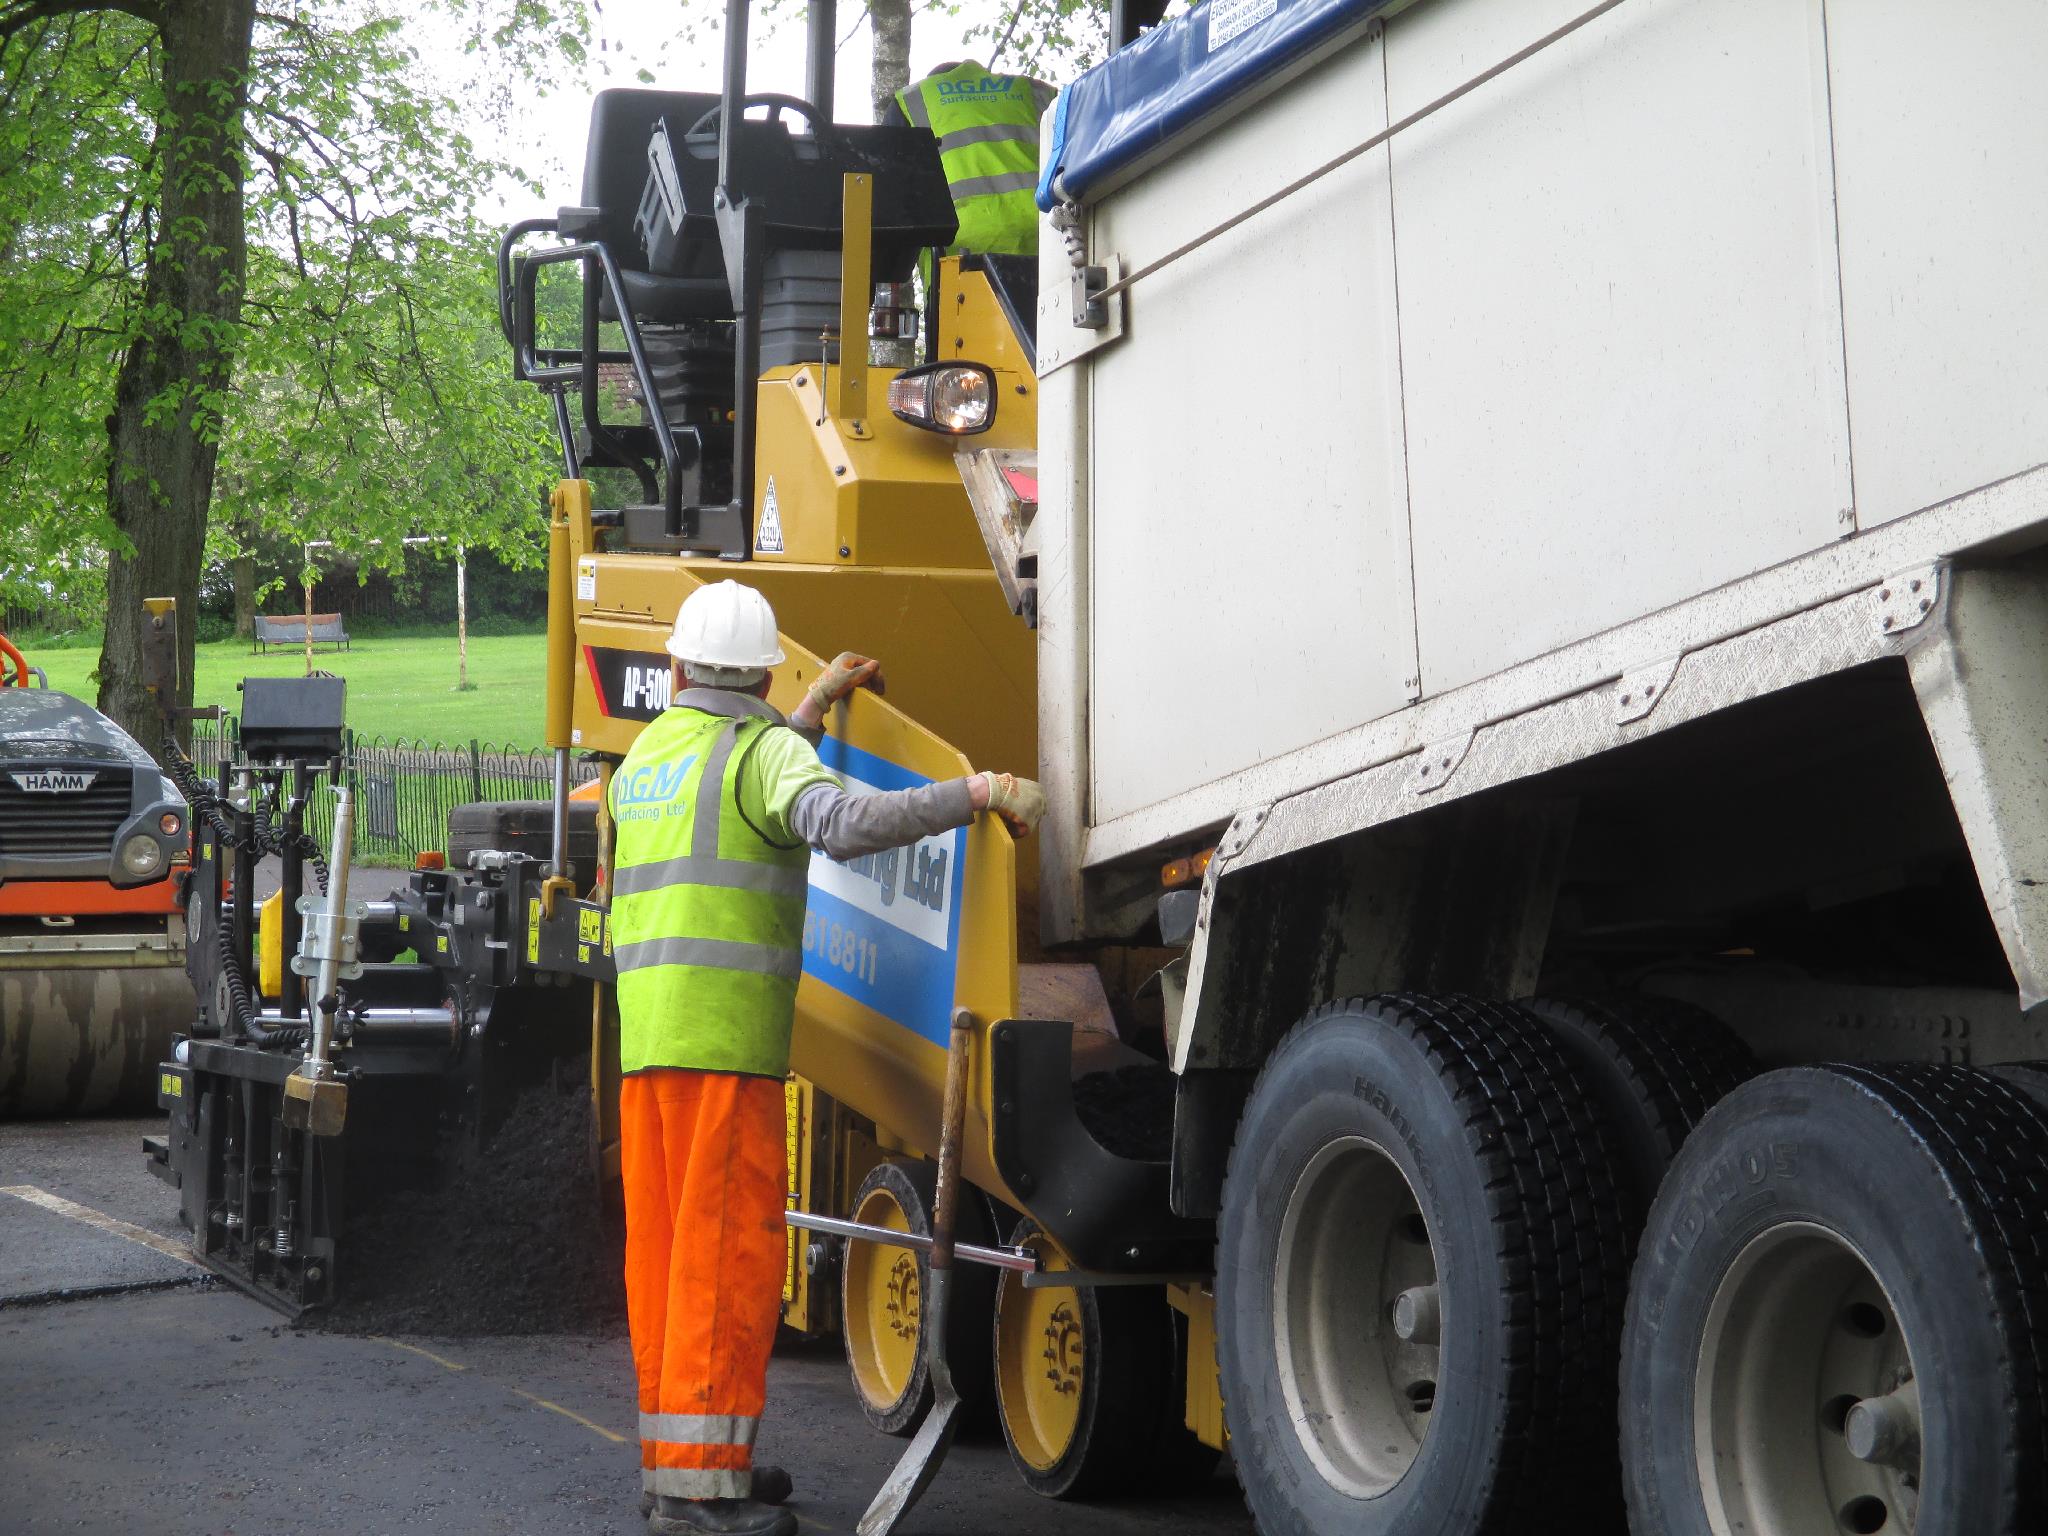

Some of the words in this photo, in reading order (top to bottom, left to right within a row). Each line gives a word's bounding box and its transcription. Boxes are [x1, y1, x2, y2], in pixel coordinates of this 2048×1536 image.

[937, 76, 1015, 95] DGM
[941, 93, 998, 105] Surfacing
[26, 775, 84, 789] HAMM
[666, 801, 685, 816] Ltd
[903, 843, 947, 913] Ltd
